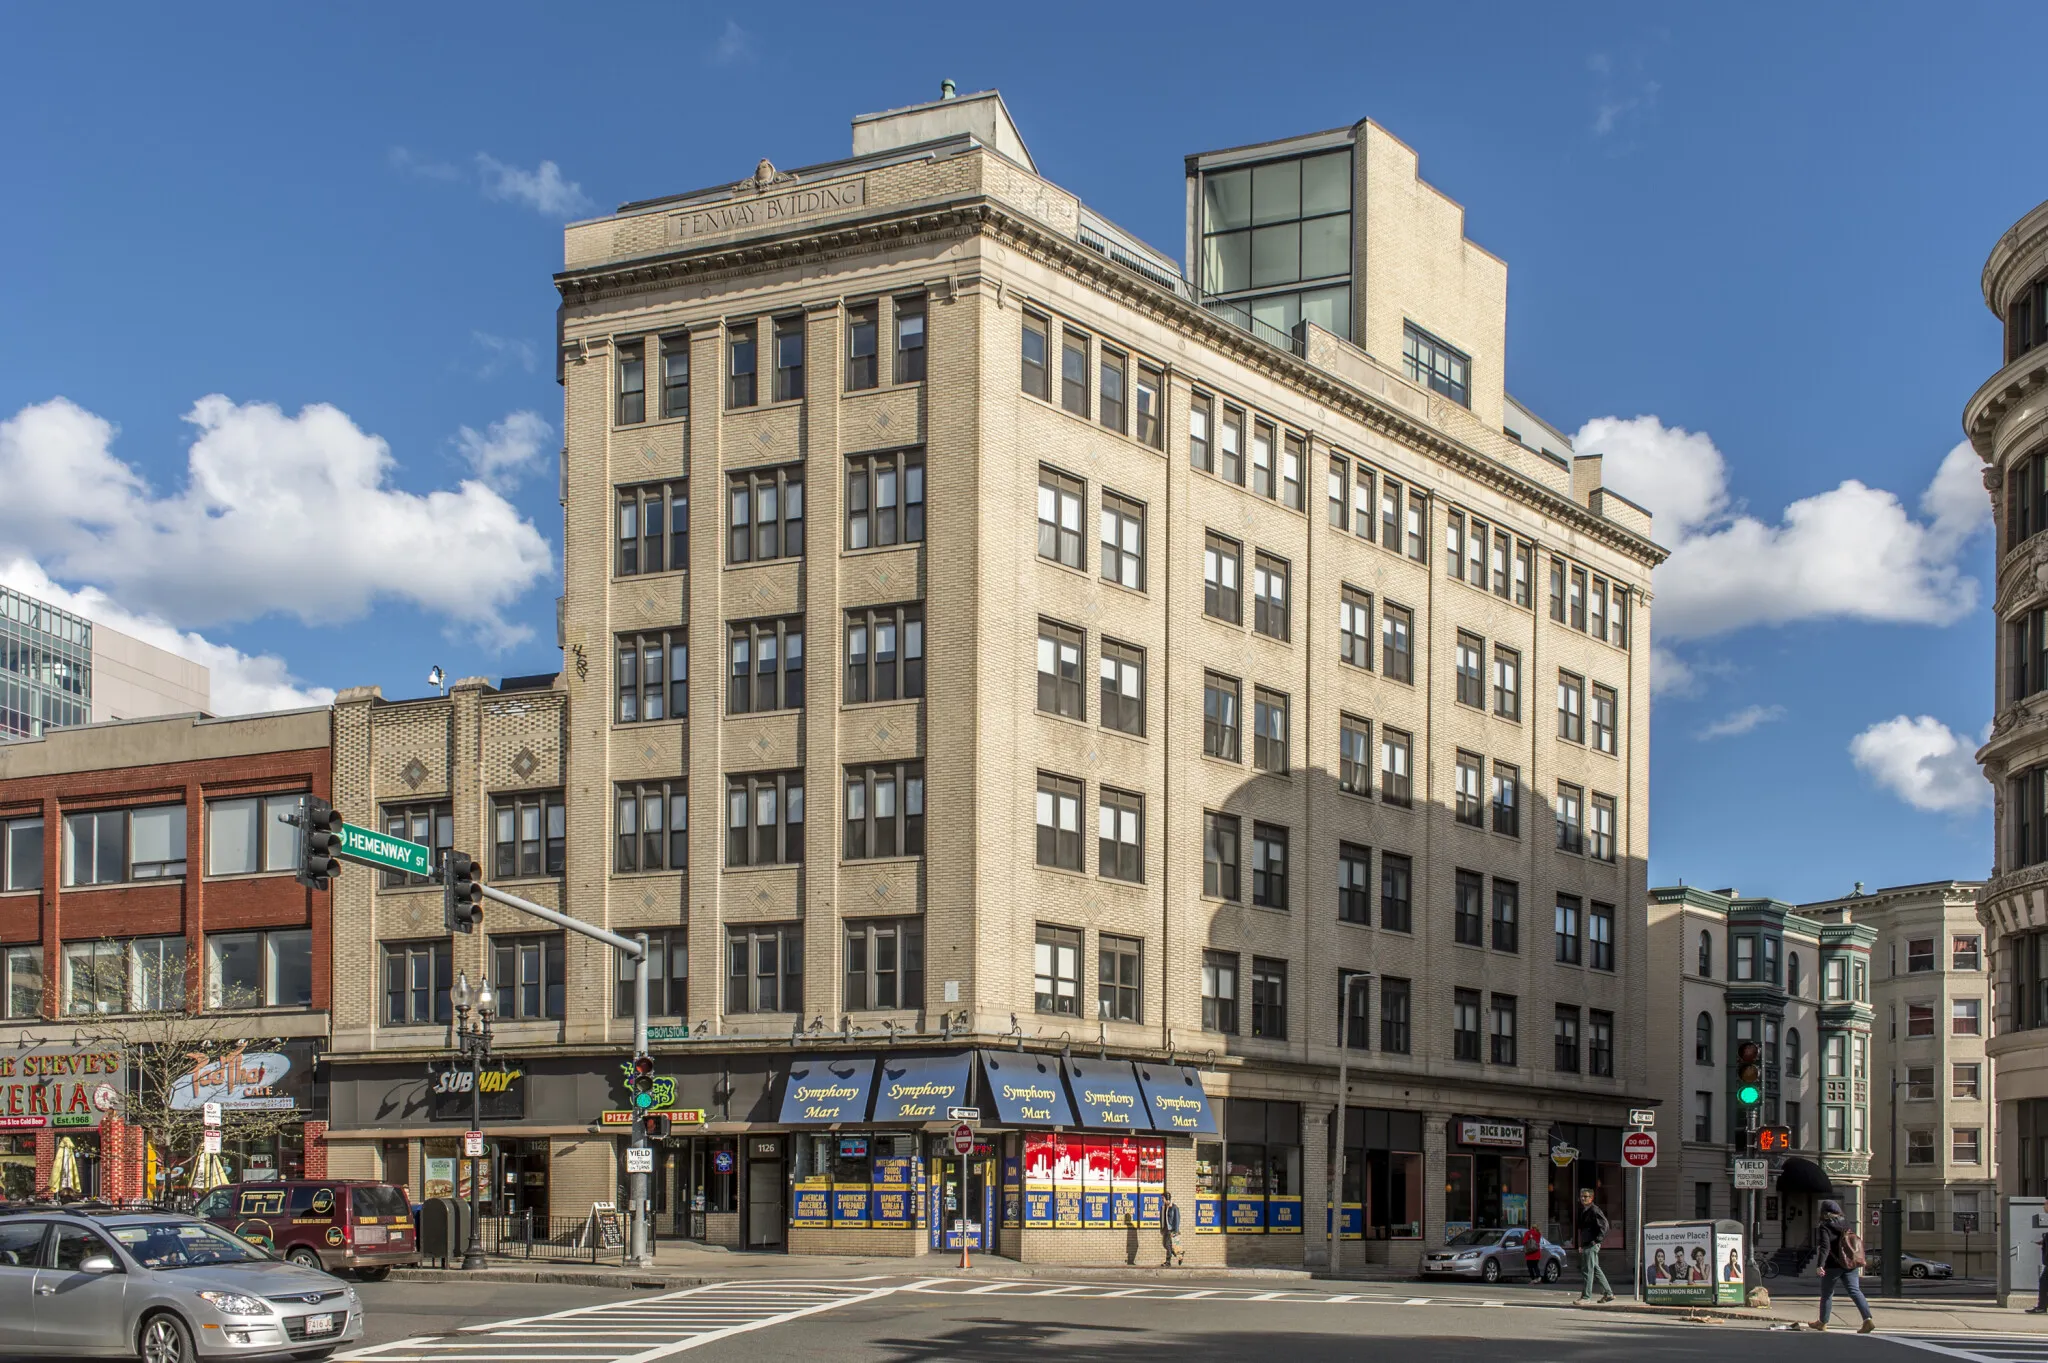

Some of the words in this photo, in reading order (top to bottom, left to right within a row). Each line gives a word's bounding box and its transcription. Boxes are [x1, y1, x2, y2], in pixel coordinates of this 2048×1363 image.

[679, 202, 759, 237] FENWAY
[349, 832, 412, 863] HEMENWAY
[415, 856, 425, 867] ST
[654, 1026, 685, 1039] BOYLSTON
[0, 1056, 16, 1077] E
[23, 1053, 119, 1076] STEVE'S
[433, 1070, 520, 1094] SUBWAY
[794, 1084, 859, 1102] Symphony
[887, 1081, 956, 1099] Symphony
[1003, 1085, 1056, 1103] Symphony
[0, 1083, 91, 1115] ERIA
[1084, 1090, 1135, 1108] Symphony
[1156, 1096, 1202, 1112] Symphony
[672, 1113, 695, 1121] BEER
[804, 1105, 840, 1119] Mart
[899, 1103, 936, 1117] Mart
[1021, 1106, 1051, 1120] Mart
[1102, 1111, 1130, 1123] Mart
[32, 1117, 44, 1125] Beer
[606, 1114, 633, 1122] PIZZA
[1172, 1115, 1198, 1127] Mart
[1480, 1125, 1499, 1137] RICE
[1501, 1127, 1523, 1138] BOWL
[531, 1141, 549, 1150] 1122
[1780, 1134, 1788, 1147] 5
[758, 1144, 775, 1153] 1126
